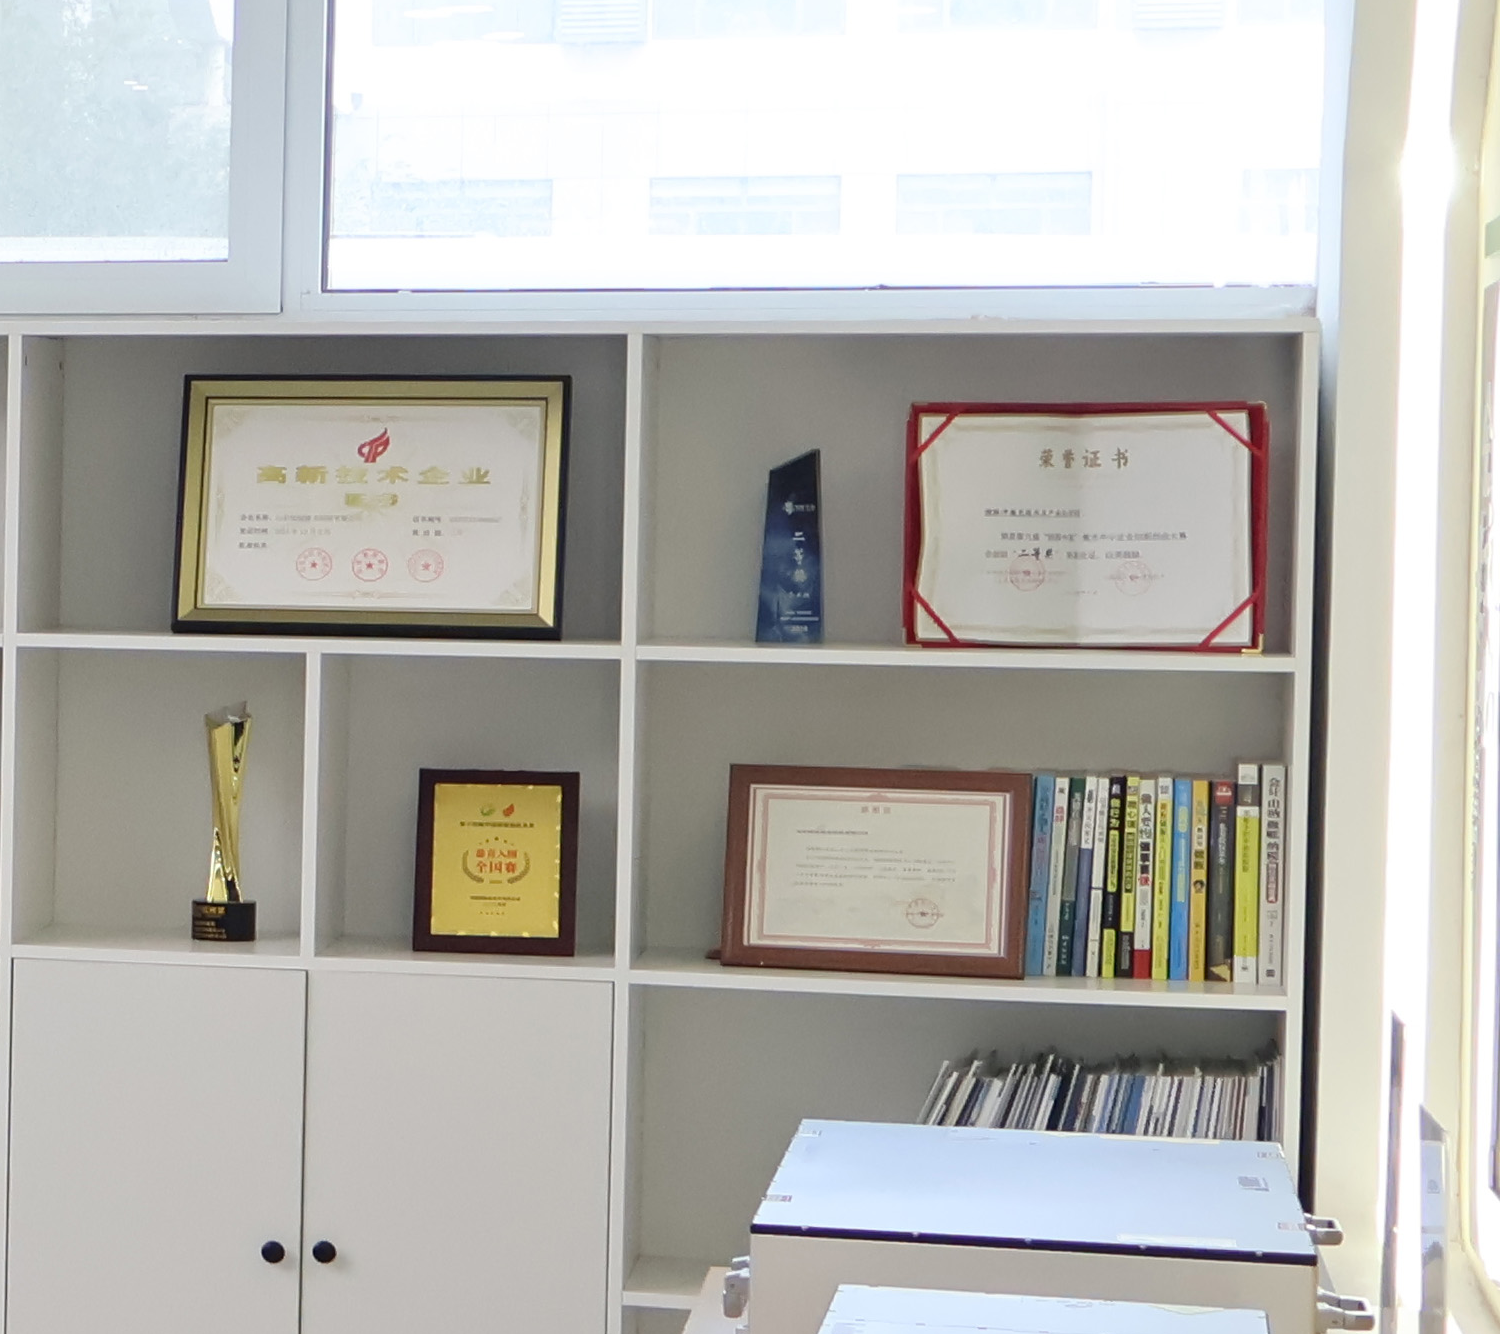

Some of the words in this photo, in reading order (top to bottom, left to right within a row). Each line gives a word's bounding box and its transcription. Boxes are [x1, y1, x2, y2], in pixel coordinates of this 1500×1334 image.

[1039, 447, 1129, 469] 荣誉证书
[256, 465, 491, 484] 高新技术企业
